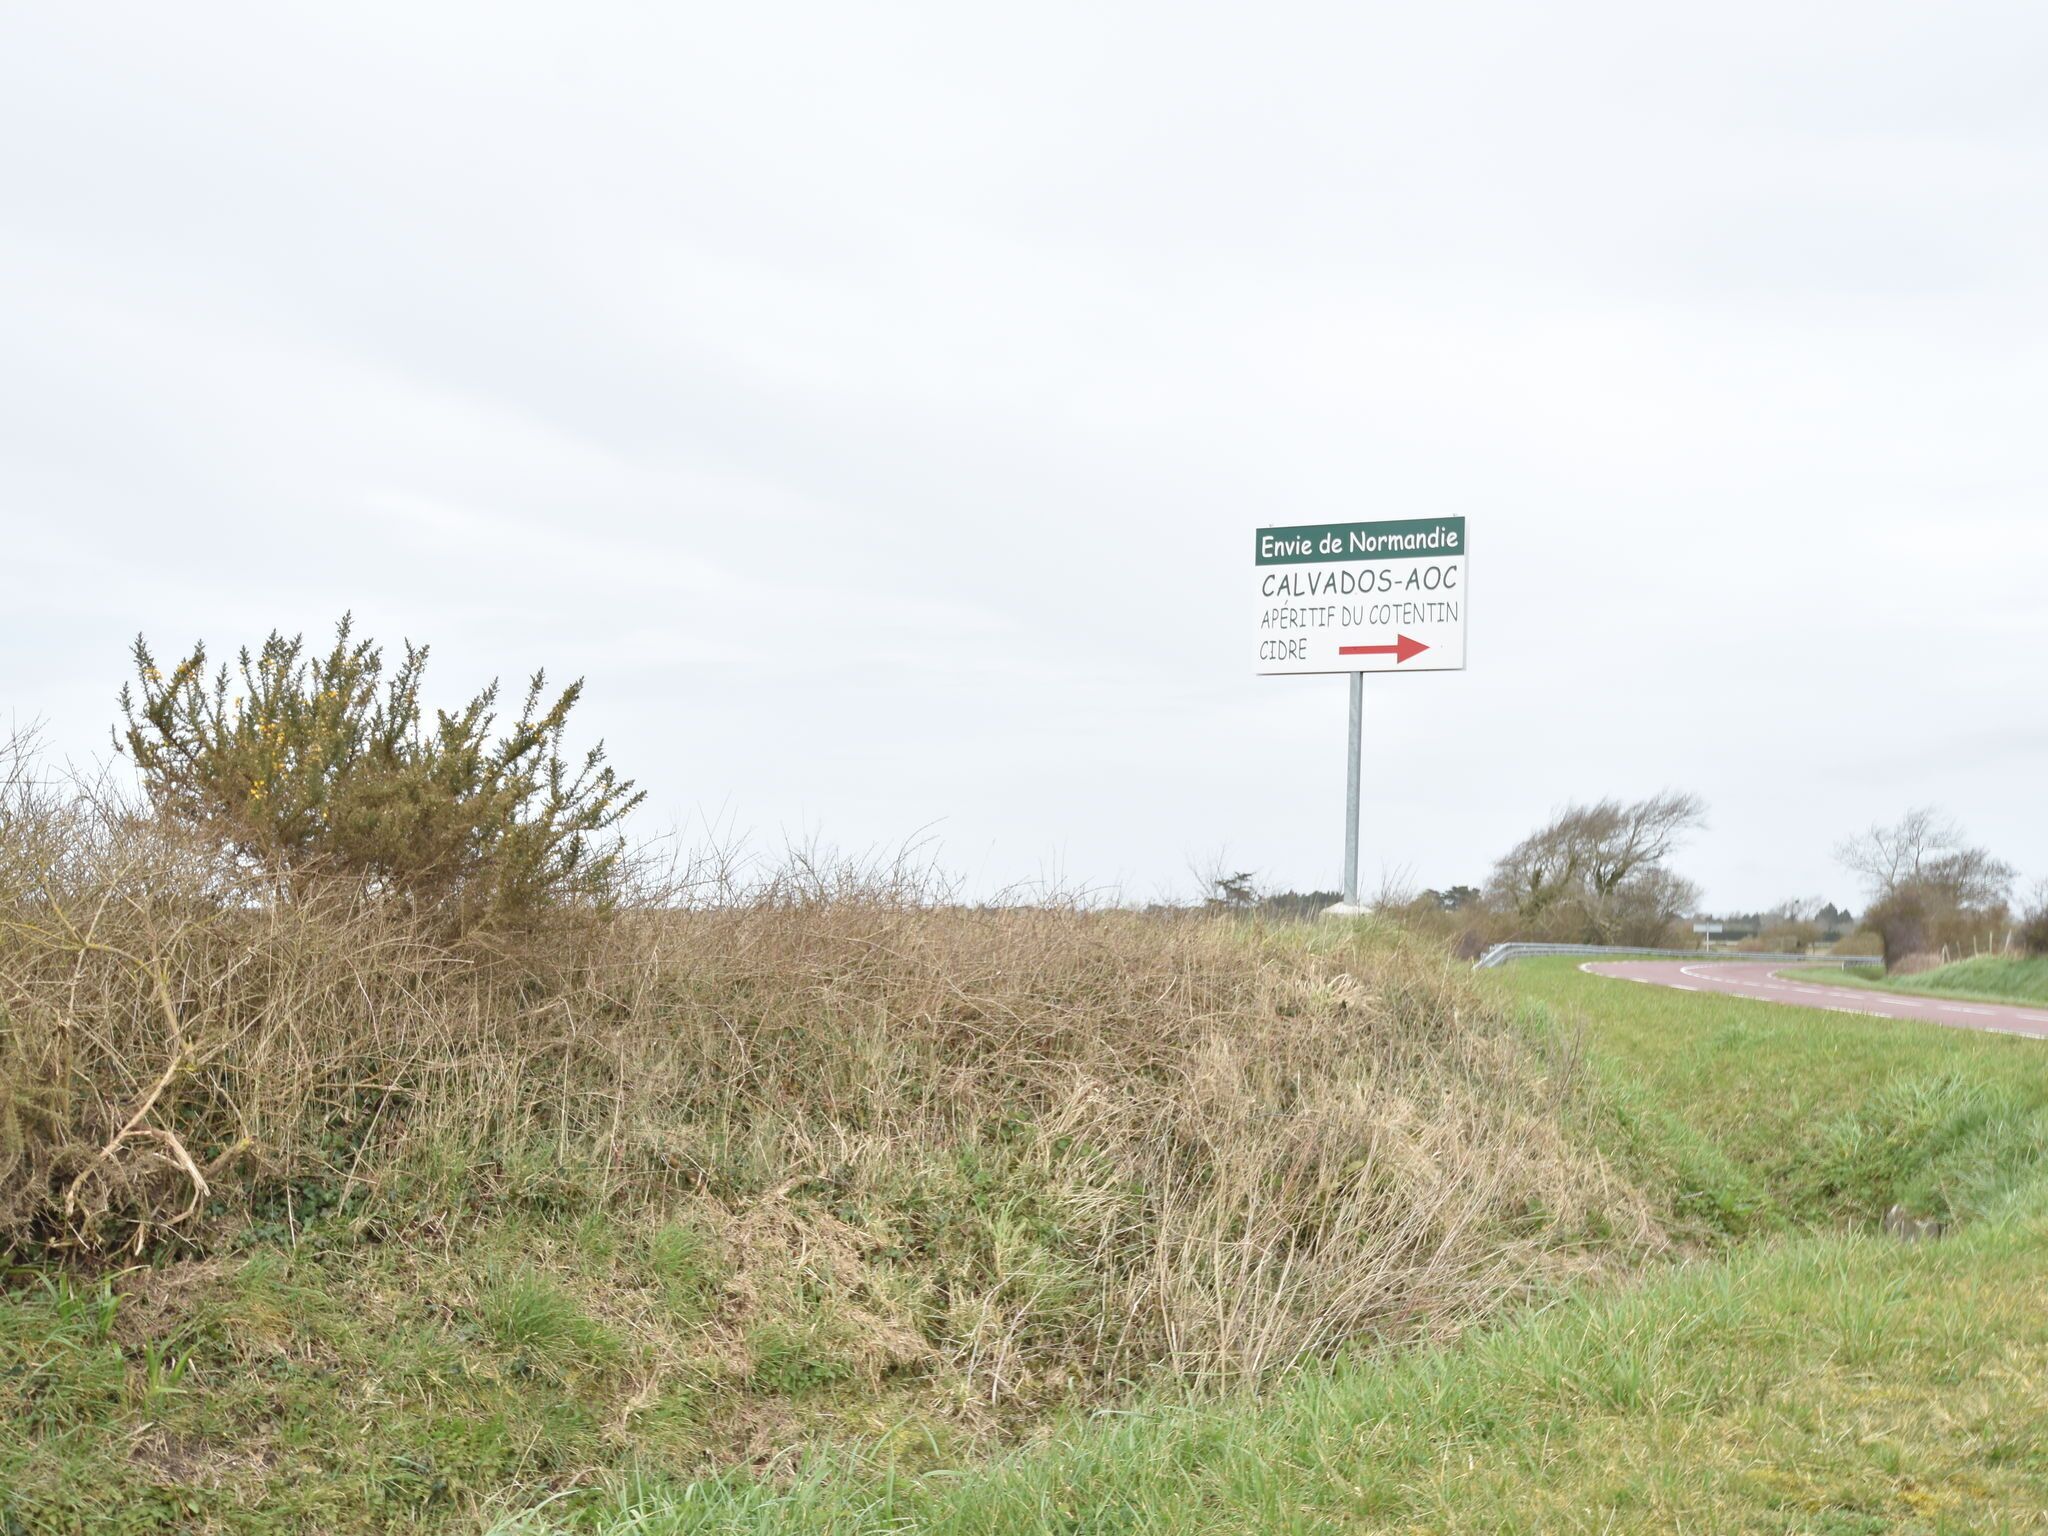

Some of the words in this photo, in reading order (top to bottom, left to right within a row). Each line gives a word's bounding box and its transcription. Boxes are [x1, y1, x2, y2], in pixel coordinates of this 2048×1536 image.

[1261, 535, 1313, 558] Envie
[1319, 532, 1343, 554] de
[1349, 526, 1459, 553] Normandie
[1261, 565, 1458, 597] CALVADOS-AOC
[1260, 599, 1336, 629] APÉRITIF
[1341, 605, 1364, 627] DU
[1369, 601, 1459, 625] COTENTIN
[1259, 638, 1308, 660] CIDRE
